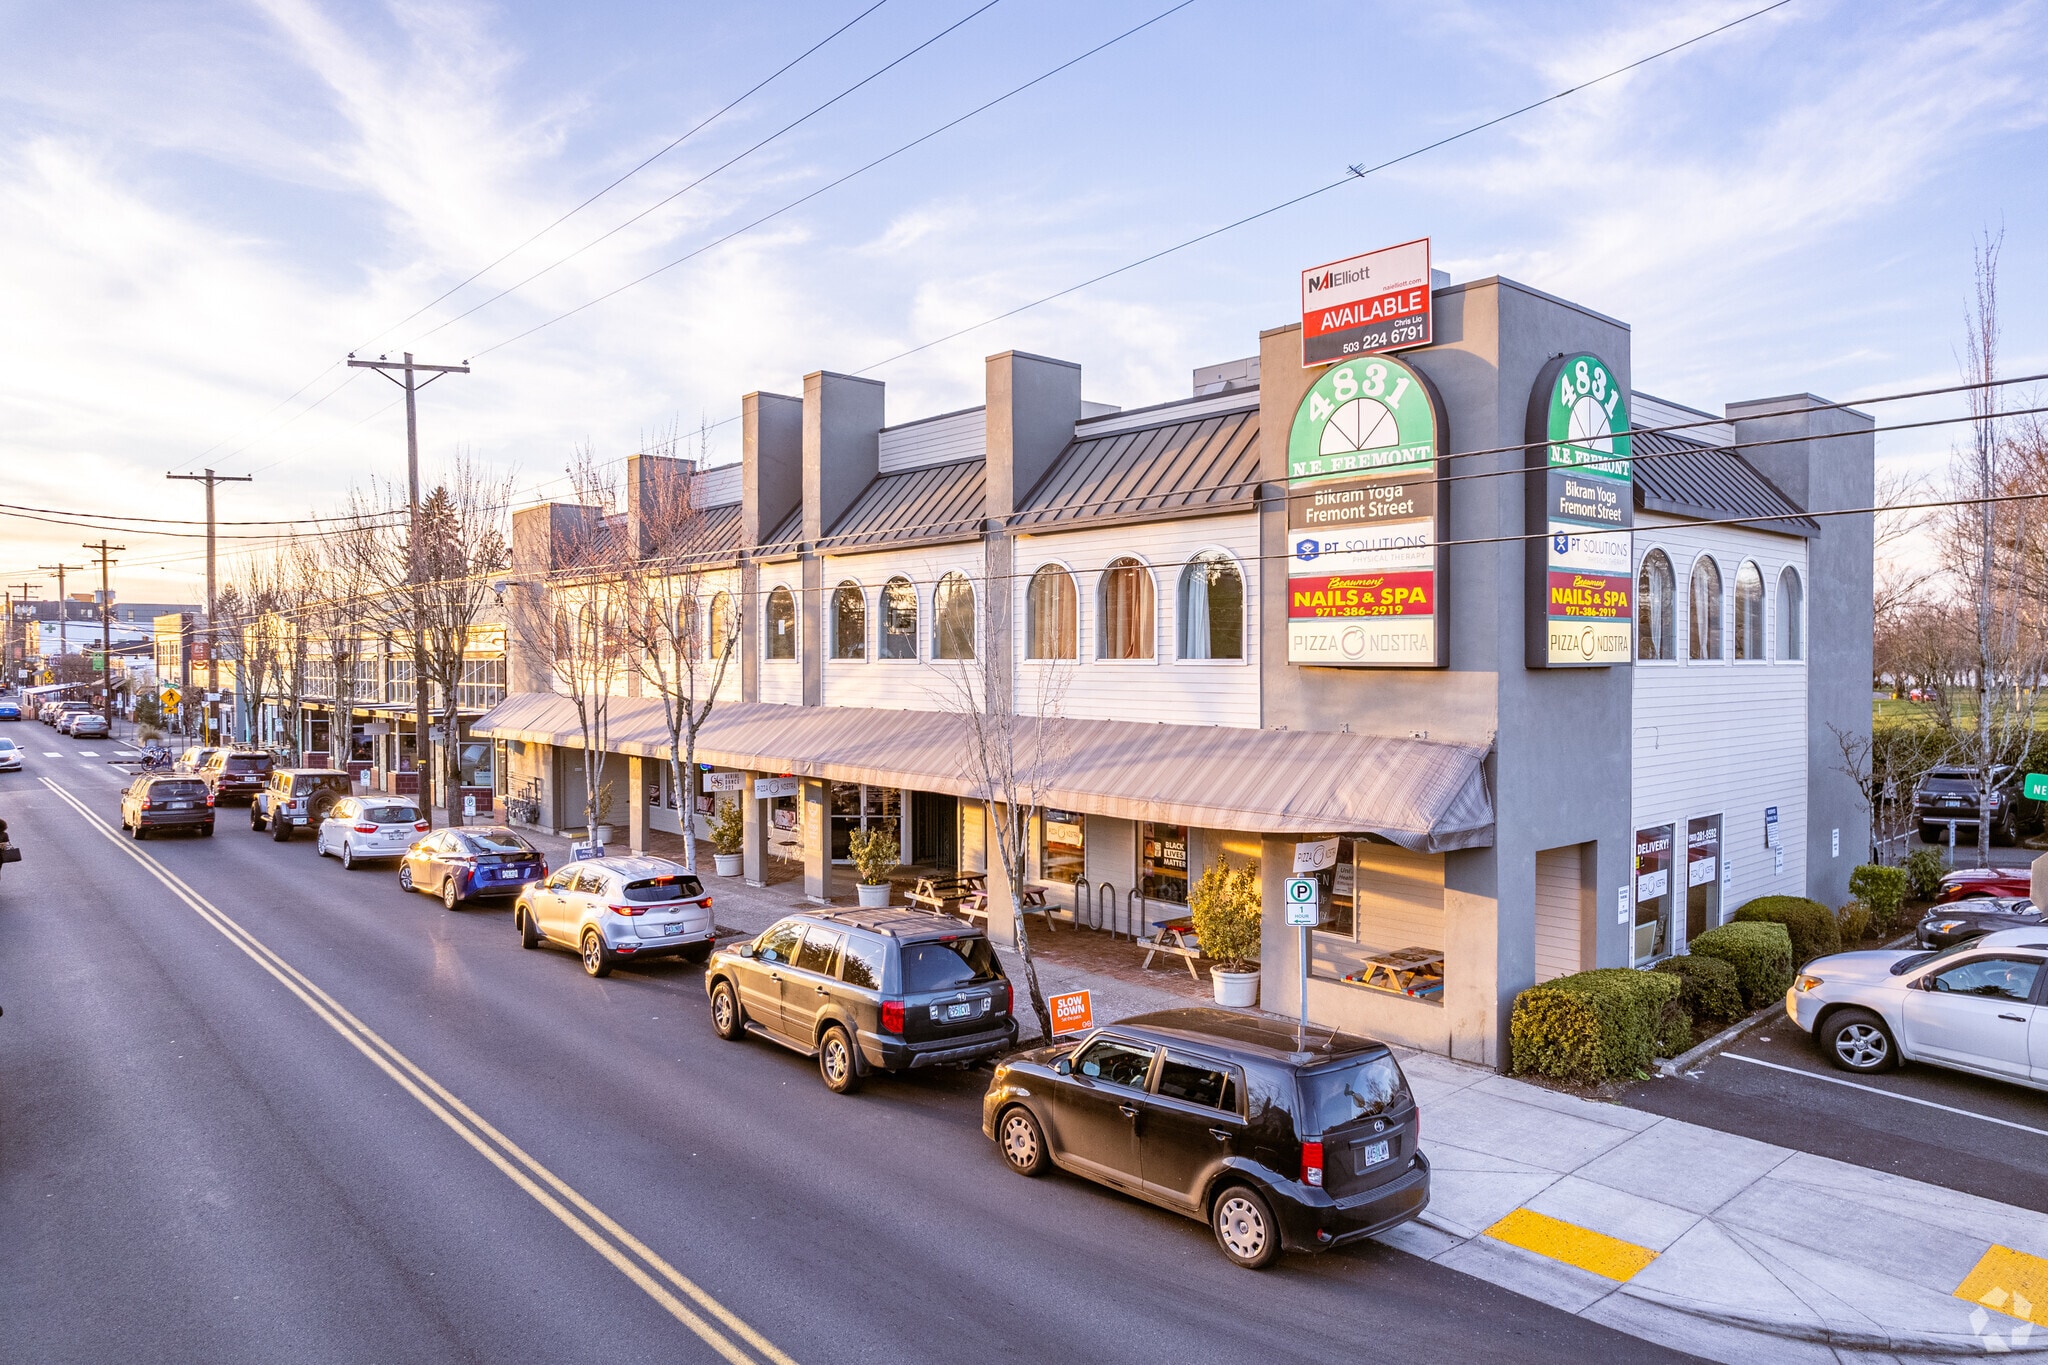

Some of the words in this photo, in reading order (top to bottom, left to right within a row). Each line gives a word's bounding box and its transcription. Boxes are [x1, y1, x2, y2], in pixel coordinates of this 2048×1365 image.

[1382, 277, 1422, 291] naielliott.com
[1320, 290, 1422, 331] AVAILABLE
[1394, 318, 1411, 328] Chris
[1343, 341, 1360, 354] 503
[1363, 331, 1387, 350] 224
[1391, 324, 1423, 344] 6791
[1309, 363, 1410, 423] 4831
[1561, 360, 1619, 420] 4831
[1293, 459, 1325, 477] N.E.
[1331, 446, 1431, 471] FREMONT
[1550, 445, 1573, 464] N.E.
[1575, 450, 1629, 476] FREMONT
[1314, 488, 1364, 506] Bikram
[1368, 484, 1403, 502] Yoga
[1565, 480, 1596, 501] Bikram
[1597, 486, 1617, 507] Yoga
[1306, 504, 1365, 523] Fremont
[1368, 499, 1414, 515] Street
[1560, 497, 1596, 518] Fremont
[1598, 503, 1622, 522] Street
[1324, 541, 1339, 555] PT
[1345, 534, 1426, 554] SOLUTIONS
[1571, 538, 1580, 551] PT
[1583, 539, 1628, 557] SOLUTIONS
[1352, 554, 1389, 563] PHYSICAL
[1391, 552, 1426, 561] THERAPY
[1327, 576, 1385, 589] Beaumont
[1294, 589, 1359, 607] NAILS
[1361, 592, 1375, 603] &
[1380, 587, 1427, 605] SPA
[1551, 587, 1592, 605] NAILS
[1594, 593, 1602, 605] &
[1604, 591, 1628, 607] SPA
[1315, 605, 1404, 617] 971-386-2919
[1565, 606, 1617, 617] 971-386-2919
[1294, 635, 1339, 651] PIZZA
[1370, 634, 1429, 651] NOSTRA
[1550, 635, 1579, 651] PIZZA
[1597, 636, 1629, 652] NOSTRA
[756, 784, 769, 793] PIZZA
[2033, 784, 2047, 796] NE
[1165, 841, 1185, 851] BLACK
[1166, 850, 1184, 859] LIVES
[1637, 838, 1669, 855] DELIVERY!
[1163, 858, 1187, 868] MATTER
[1297, 852, 1312, 863] PIZZA
[1057, 995, 1082, 1009] SLOW
[1057, 1003, 1085, 1018] DOWN
